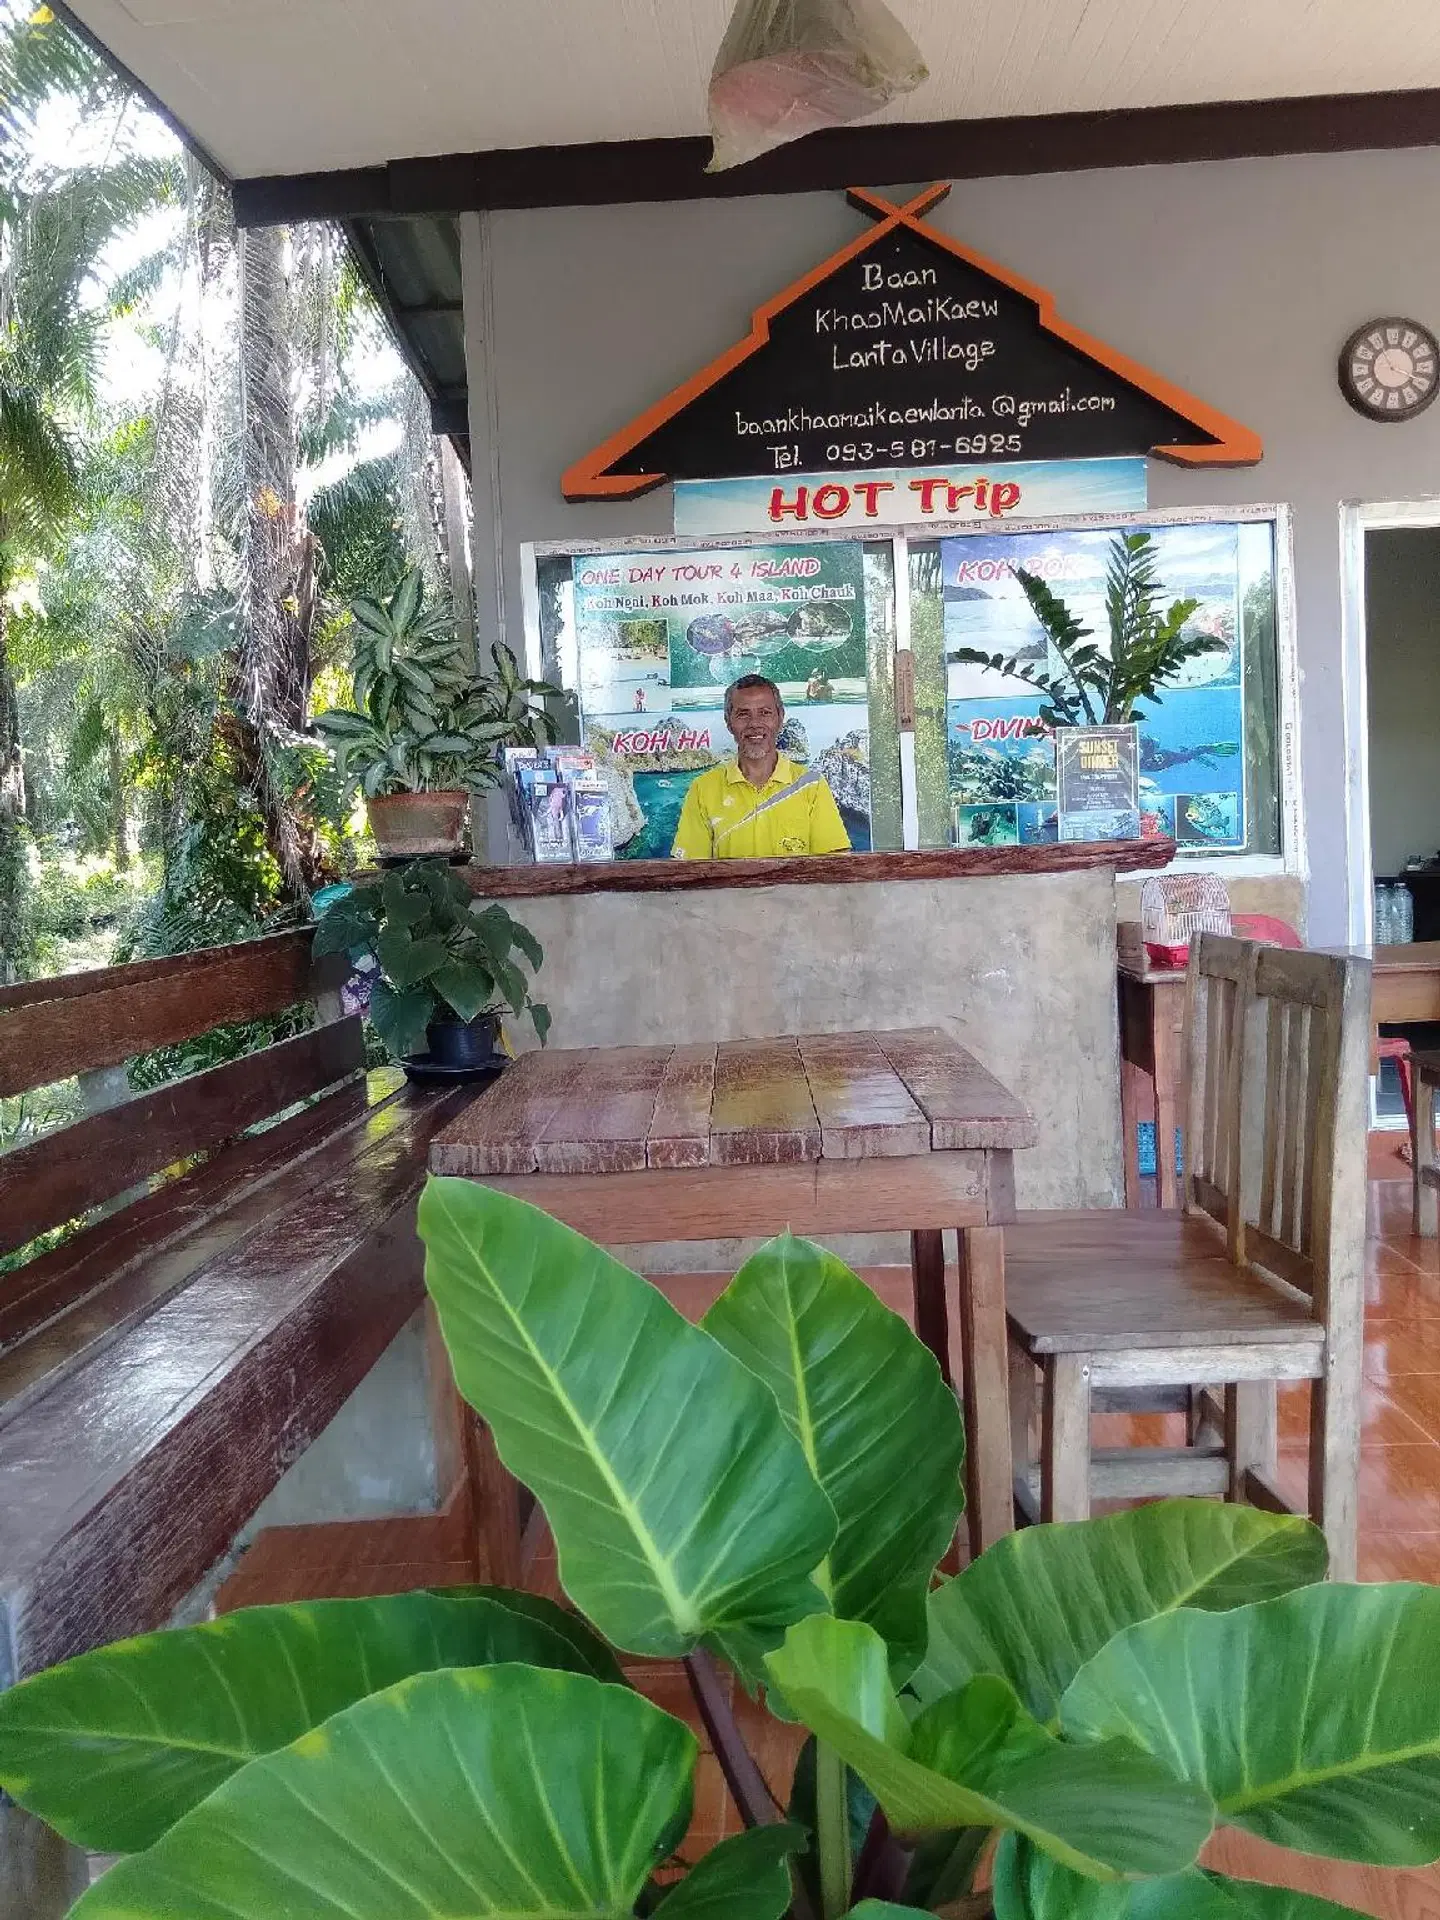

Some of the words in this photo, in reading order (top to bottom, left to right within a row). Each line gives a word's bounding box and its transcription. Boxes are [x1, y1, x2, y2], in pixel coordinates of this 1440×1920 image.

[861, 262, 937, 291] Baan
[766, 445, 803, 469] Tel.
[767, 481, 895, 521] HOT
[908, 476, 1022, 519] Trip
[581, 568, 620, 586] ONE
[628, 566, 666, 584] DAY
[672, 564, 723, 582] TOUR
[731, 562, 743, 579] 4
[751, 558, 820, 578] ISLAND
[958, 558, 1017, 582] KOH
[652, 595, 679, 608] Koh
[717, 591, 743, 604] Koh
[782, 586, 808, 600] Koh
[613, 730, 670, 753] KOH
[677, 729, 711, 750] HA
